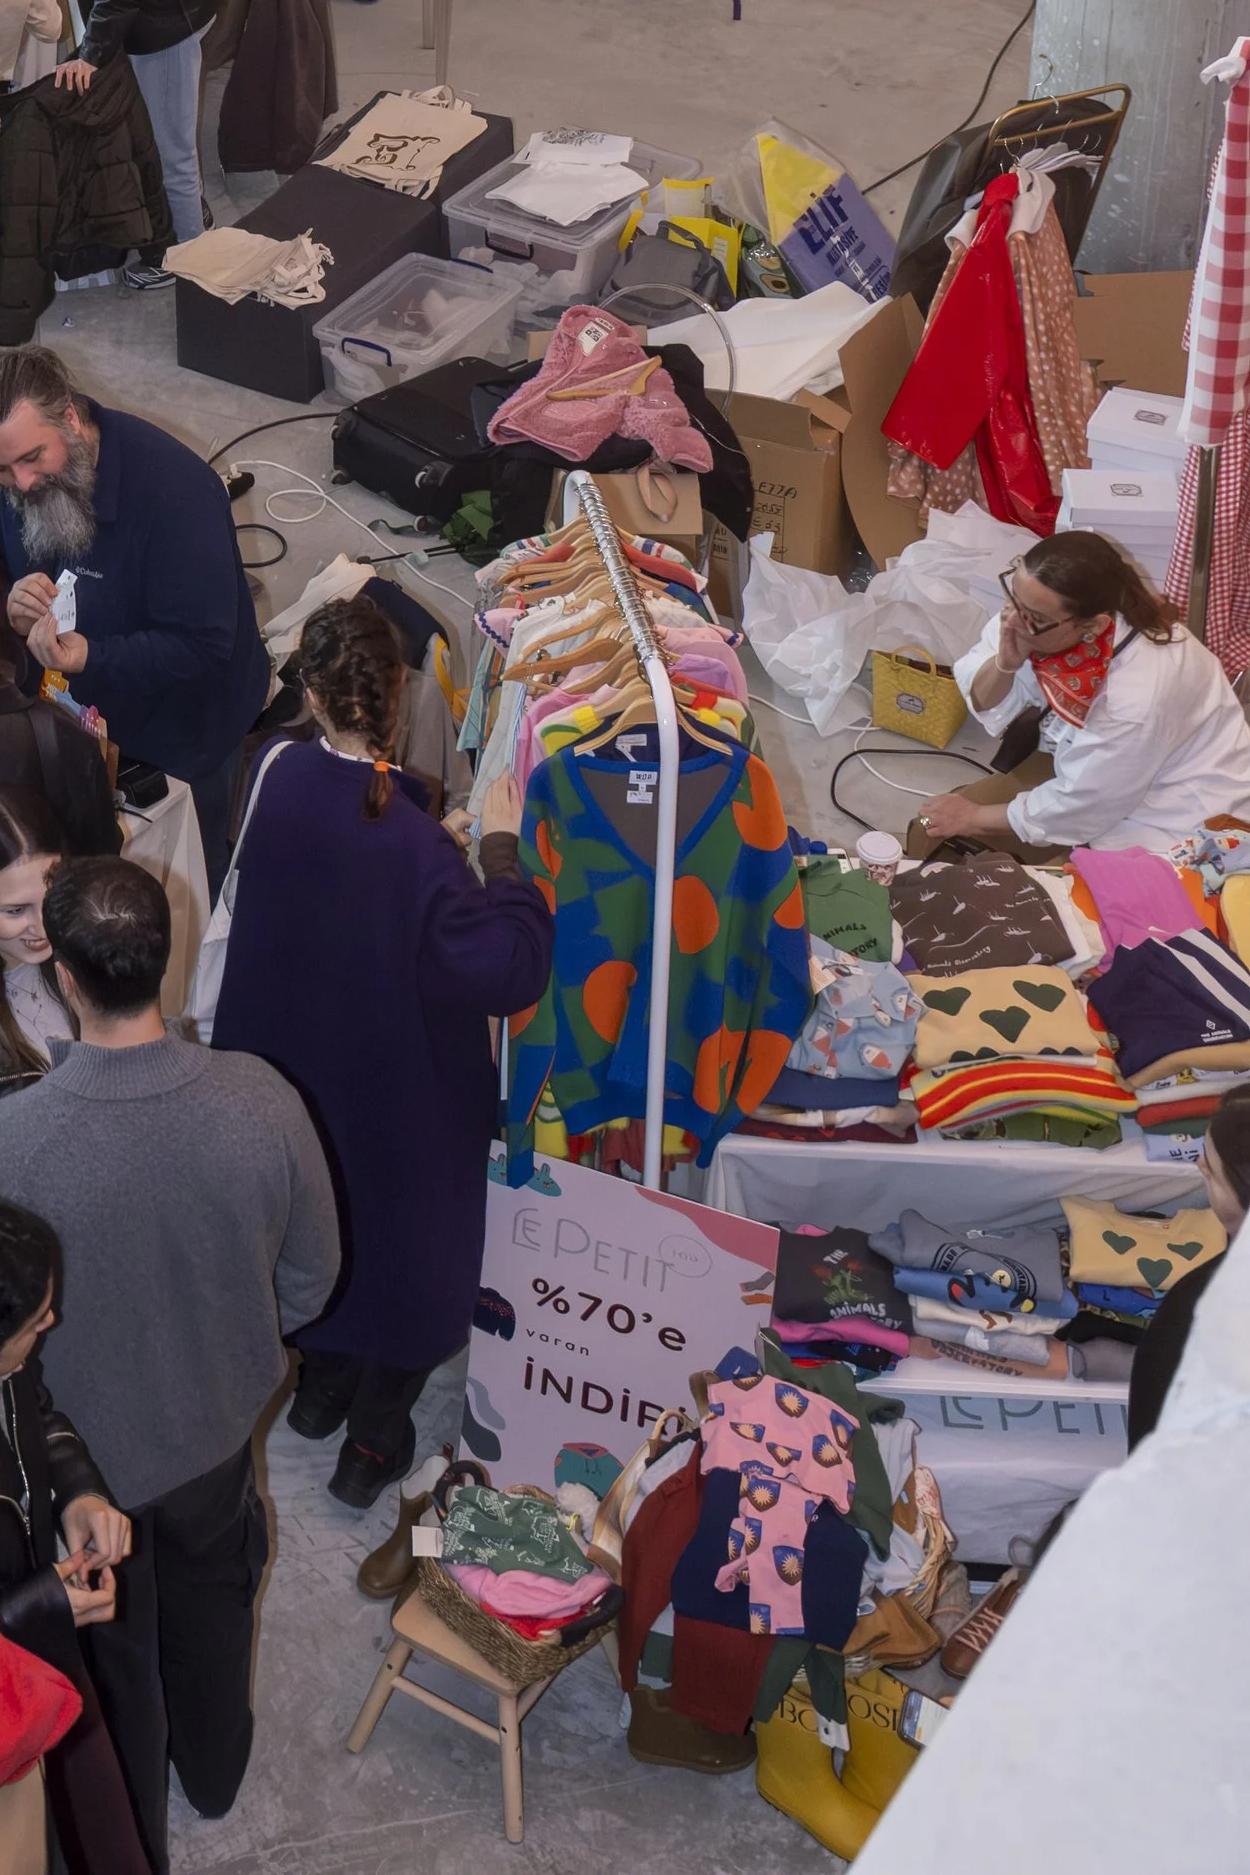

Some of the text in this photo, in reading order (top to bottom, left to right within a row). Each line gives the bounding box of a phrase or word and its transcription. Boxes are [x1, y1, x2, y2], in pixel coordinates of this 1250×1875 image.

[553, 1218, 675, 1293] PETIT
[525, 1328, 590, 1357] varan
[523, 1356, 688, 1438] İNDİRİ
